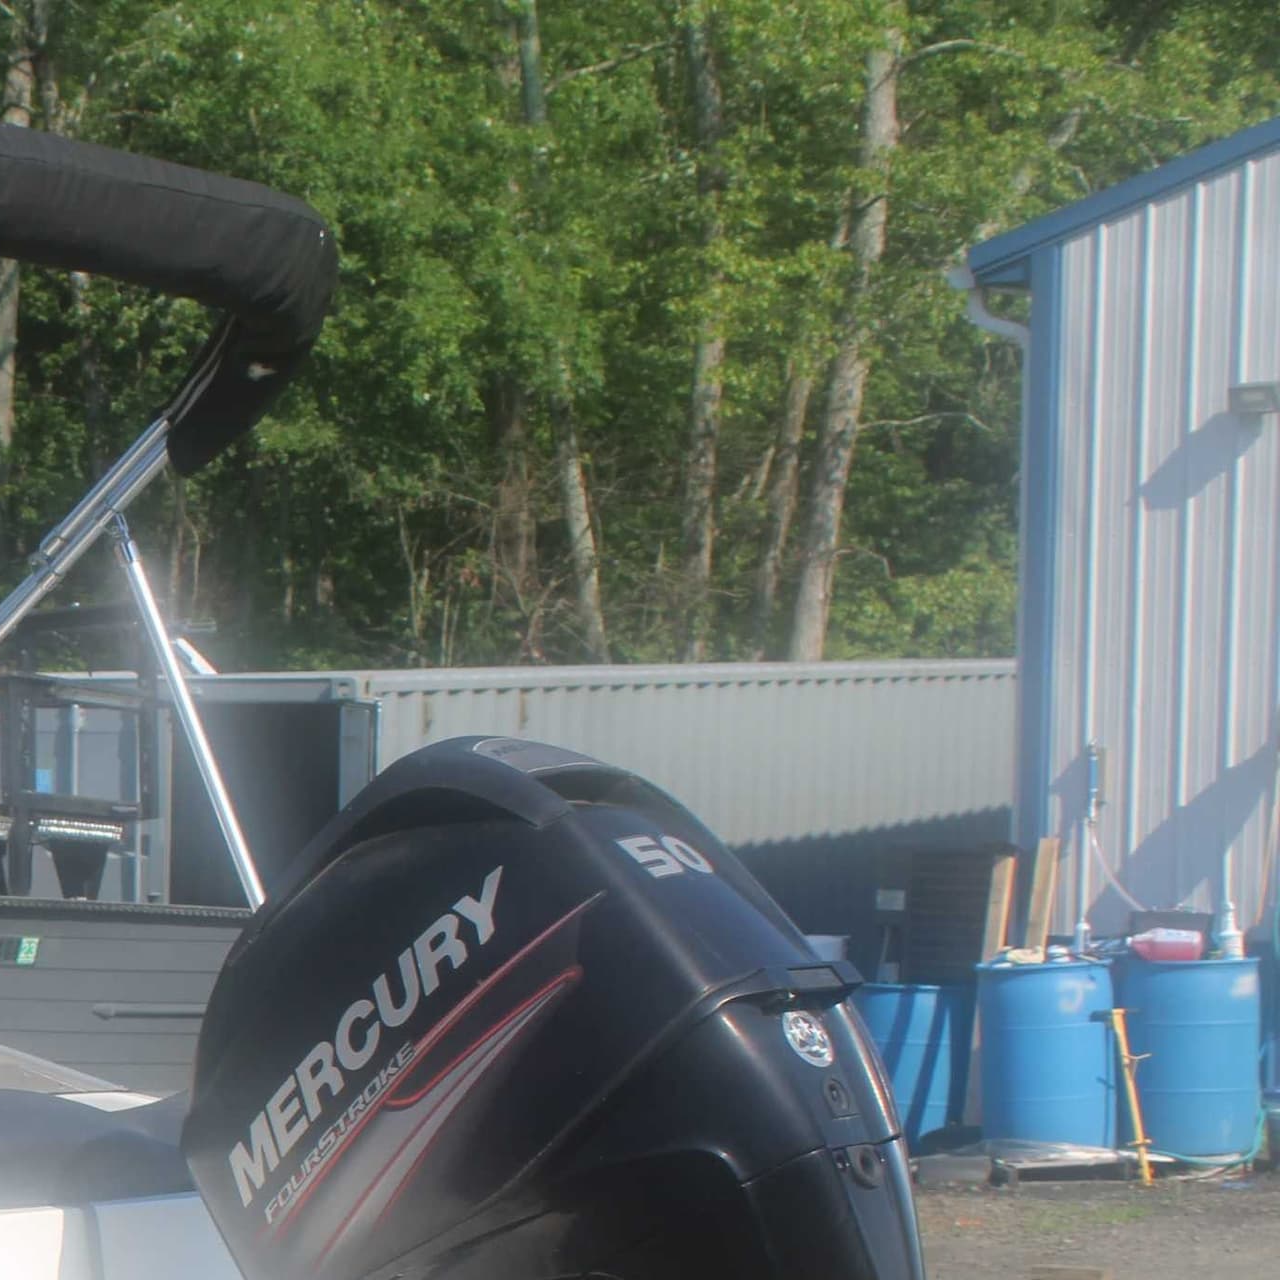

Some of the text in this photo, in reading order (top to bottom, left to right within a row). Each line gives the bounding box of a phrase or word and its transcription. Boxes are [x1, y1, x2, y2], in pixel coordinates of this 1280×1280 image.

[615, 835, 714, 878] 50
[229, 865, 503, 1207] MERCURY
[264, 1040, 417, 1225] FOURSTROKE
